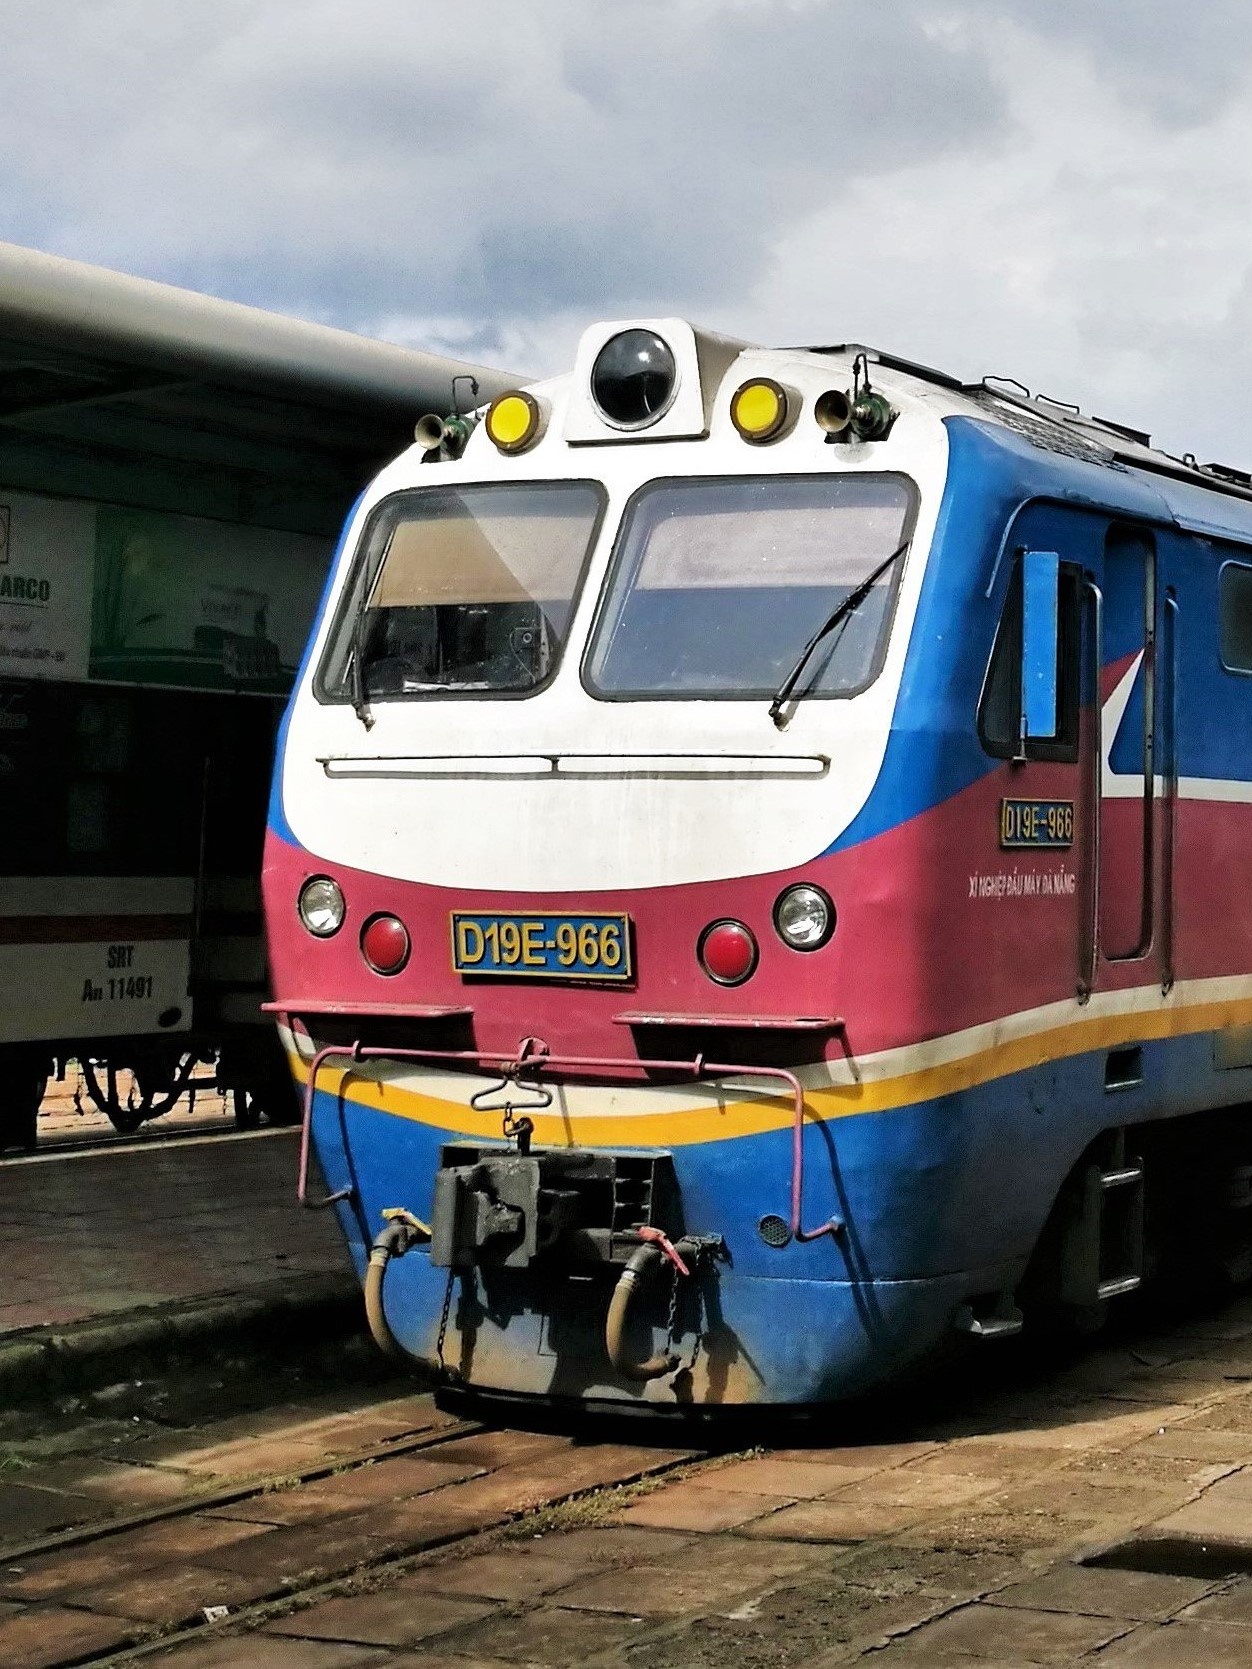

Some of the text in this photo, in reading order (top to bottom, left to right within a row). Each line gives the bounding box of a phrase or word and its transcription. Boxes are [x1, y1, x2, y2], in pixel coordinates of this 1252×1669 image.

[1005, 806, 1073, 839] D19E-966
[458, 921, 621, 967] D19E-966
[107, 976, 153, 1000] 11491
